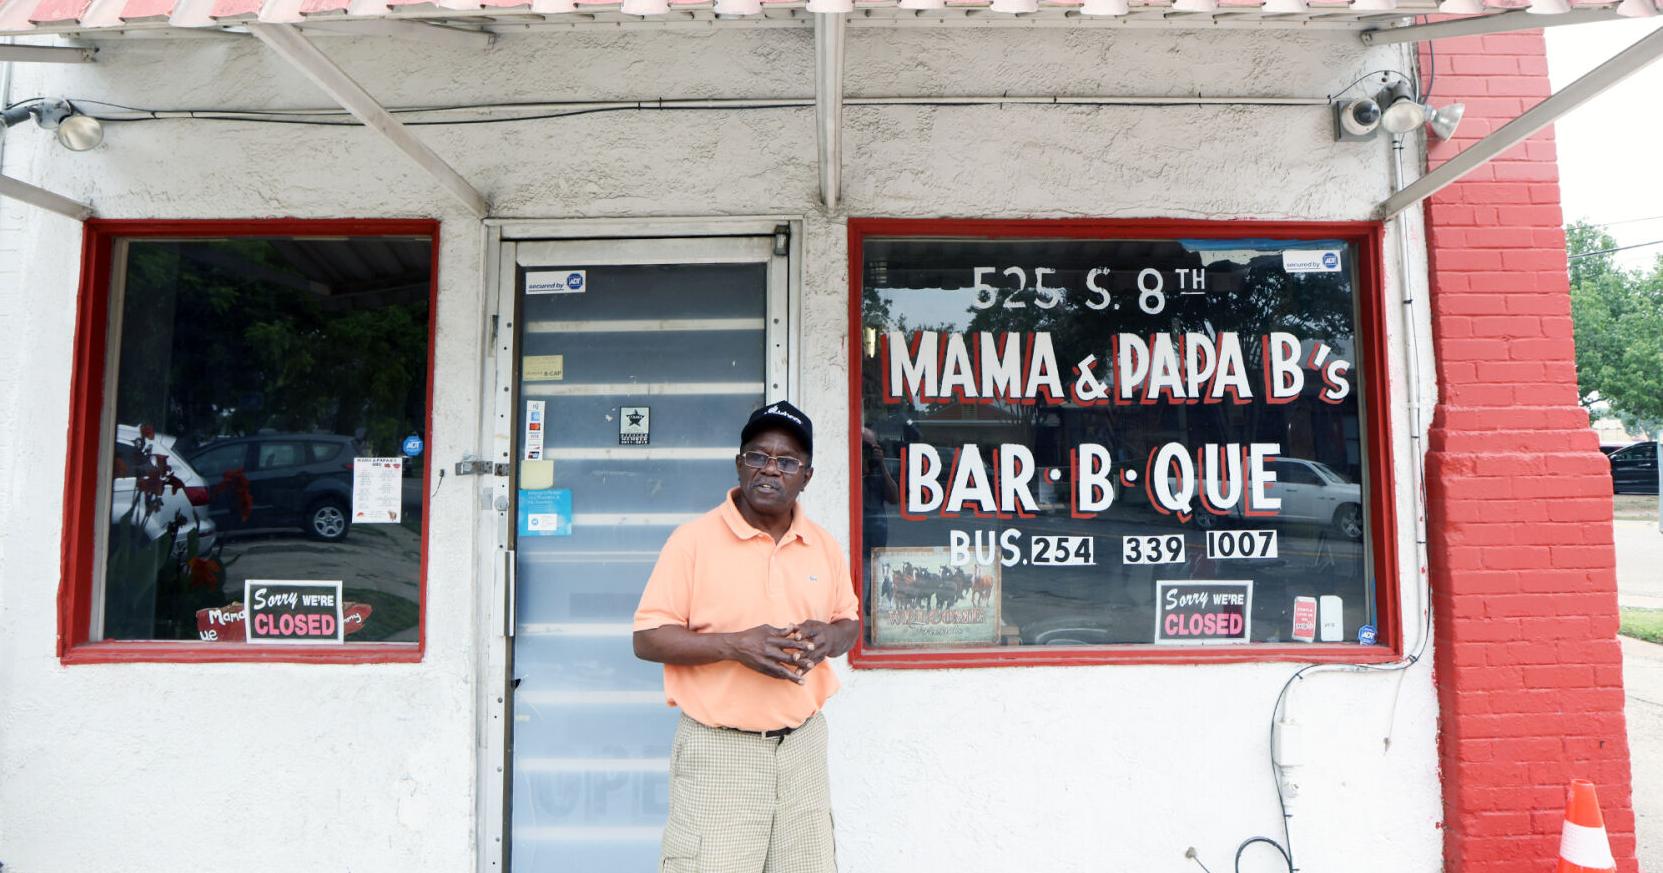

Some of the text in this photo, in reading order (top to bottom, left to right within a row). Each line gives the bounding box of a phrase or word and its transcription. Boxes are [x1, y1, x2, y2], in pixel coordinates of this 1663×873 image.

[973, 266, 1062, 310] 525
[1086, 267, 1119, 310] S.
[886, 331, 1064, 400] MAMA
[1075, 353, 1111, 402] &
[1117, 331, 1253, 400] PAPA
[949, 528, 1275, 567] BUS. 254 339 1007
[253, 588, 334, 610] Sorry WE'RE
[1165, 588, 1245, 610] Sorry WE'RE
[254, 613, 335, 636] CLOSED
[1164, 612, 1243, 636] CLOSED
